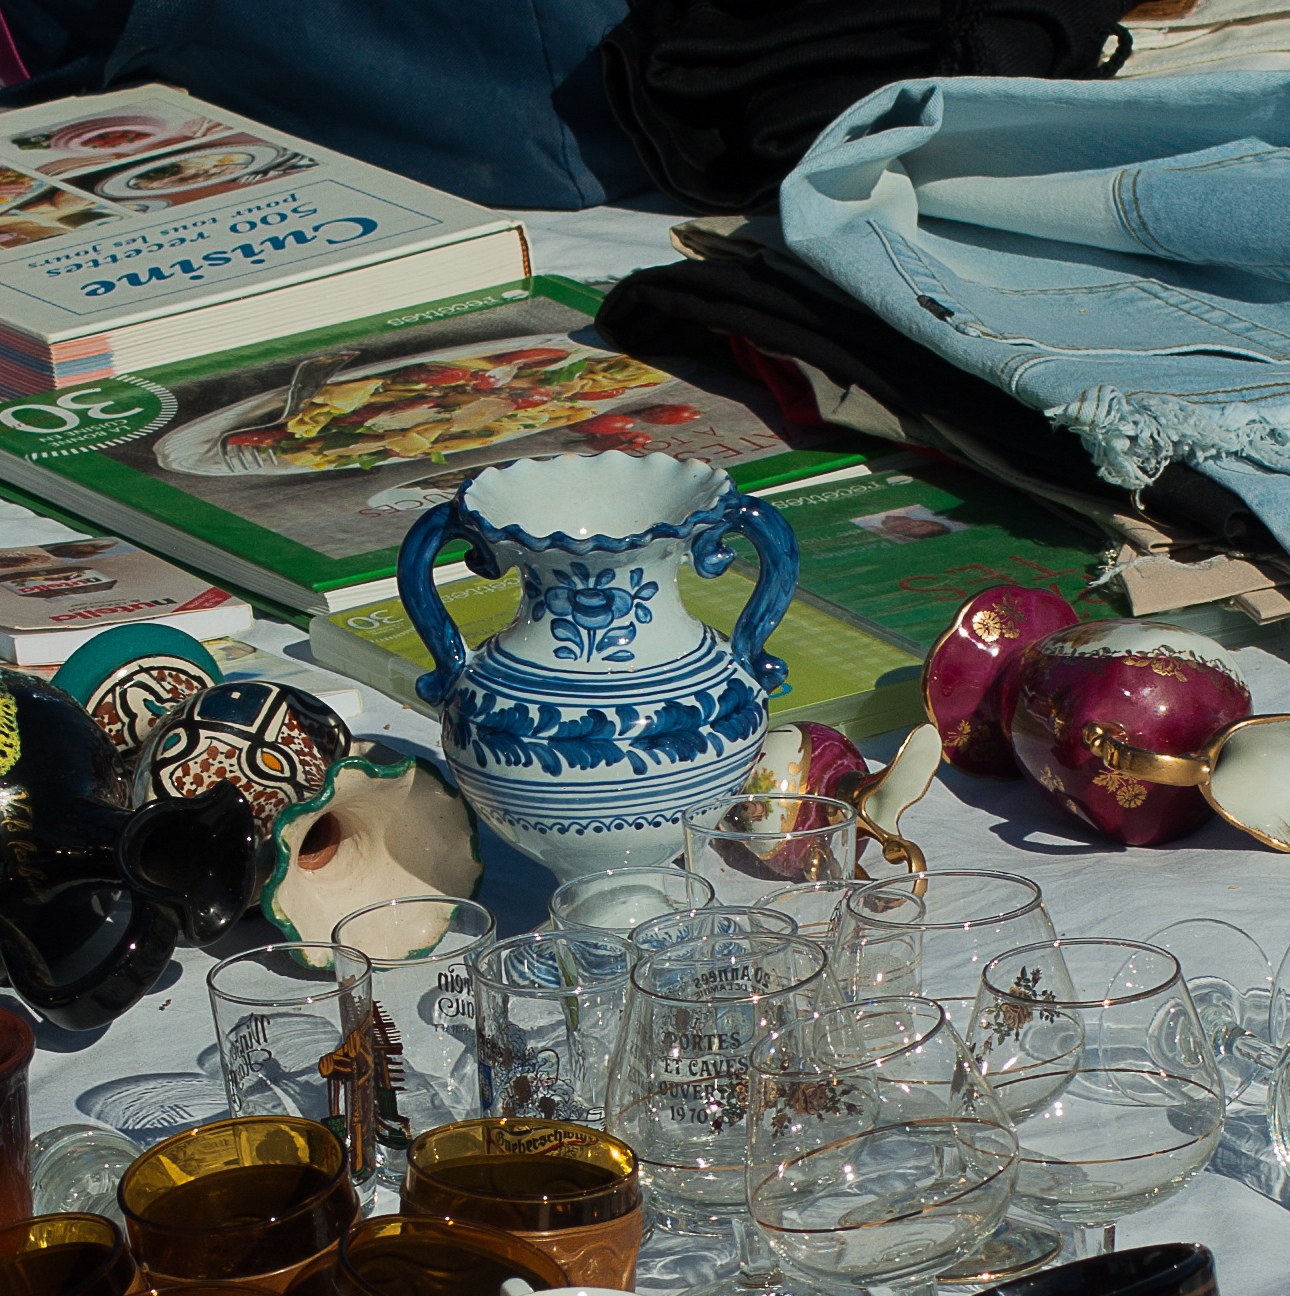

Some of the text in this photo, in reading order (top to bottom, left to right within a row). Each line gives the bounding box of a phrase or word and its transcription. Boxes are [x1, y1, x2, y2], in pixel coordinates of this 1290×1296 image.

[25, 191, 298, 270] pour tous les jours
[44, 200, 317, 279] 500 recettes
[79, 214, 378, 298] Cuisine
[386, 295, 498, 326] recettes
[38, 419, 127, 442] CUISINE EN
[47, 424, 130, 447] LA BONNE
[17, 576, 101, 593] nutella
[48, 597, 177, 622] nutella
[346, 609, 403, 629] 30
[662, 1031, 740, 1052] PORTES
[662, 1056, 749, 1076] ET CAVES
